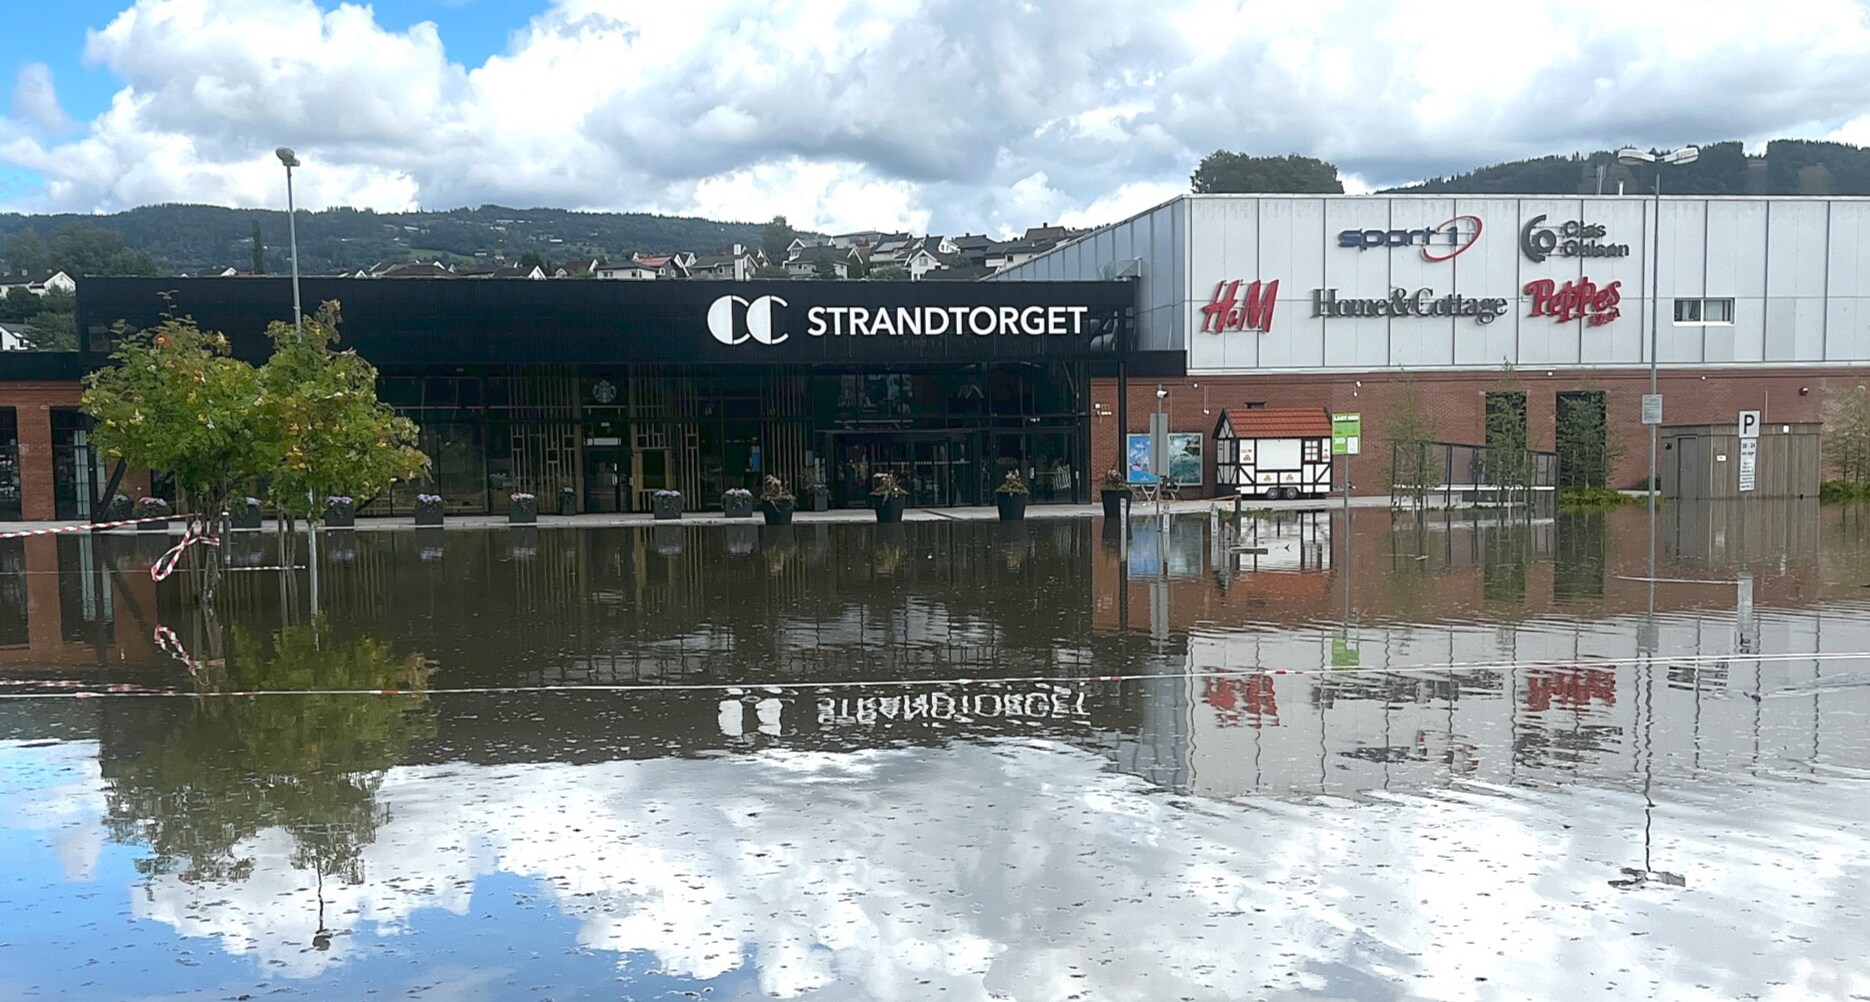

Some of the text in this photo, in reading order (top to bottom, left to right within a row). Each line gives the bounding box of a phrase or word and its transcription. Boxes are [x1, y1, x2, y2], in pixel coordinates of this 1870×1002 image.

[1338, 226, 1436, 251] sport
[1562, 220, 1607, 239] Clas
[1562, 239, 1630, 258] Ohlson
[1202, 279, 1280, 333] H&M
[1311, 287, 1508, 325] Home&Cottage
[1523, 276, 1622, 324] Peppes
[807, 306, 1089, 337] STRANDTORGET
[1744, 414, 1755, 434] P
